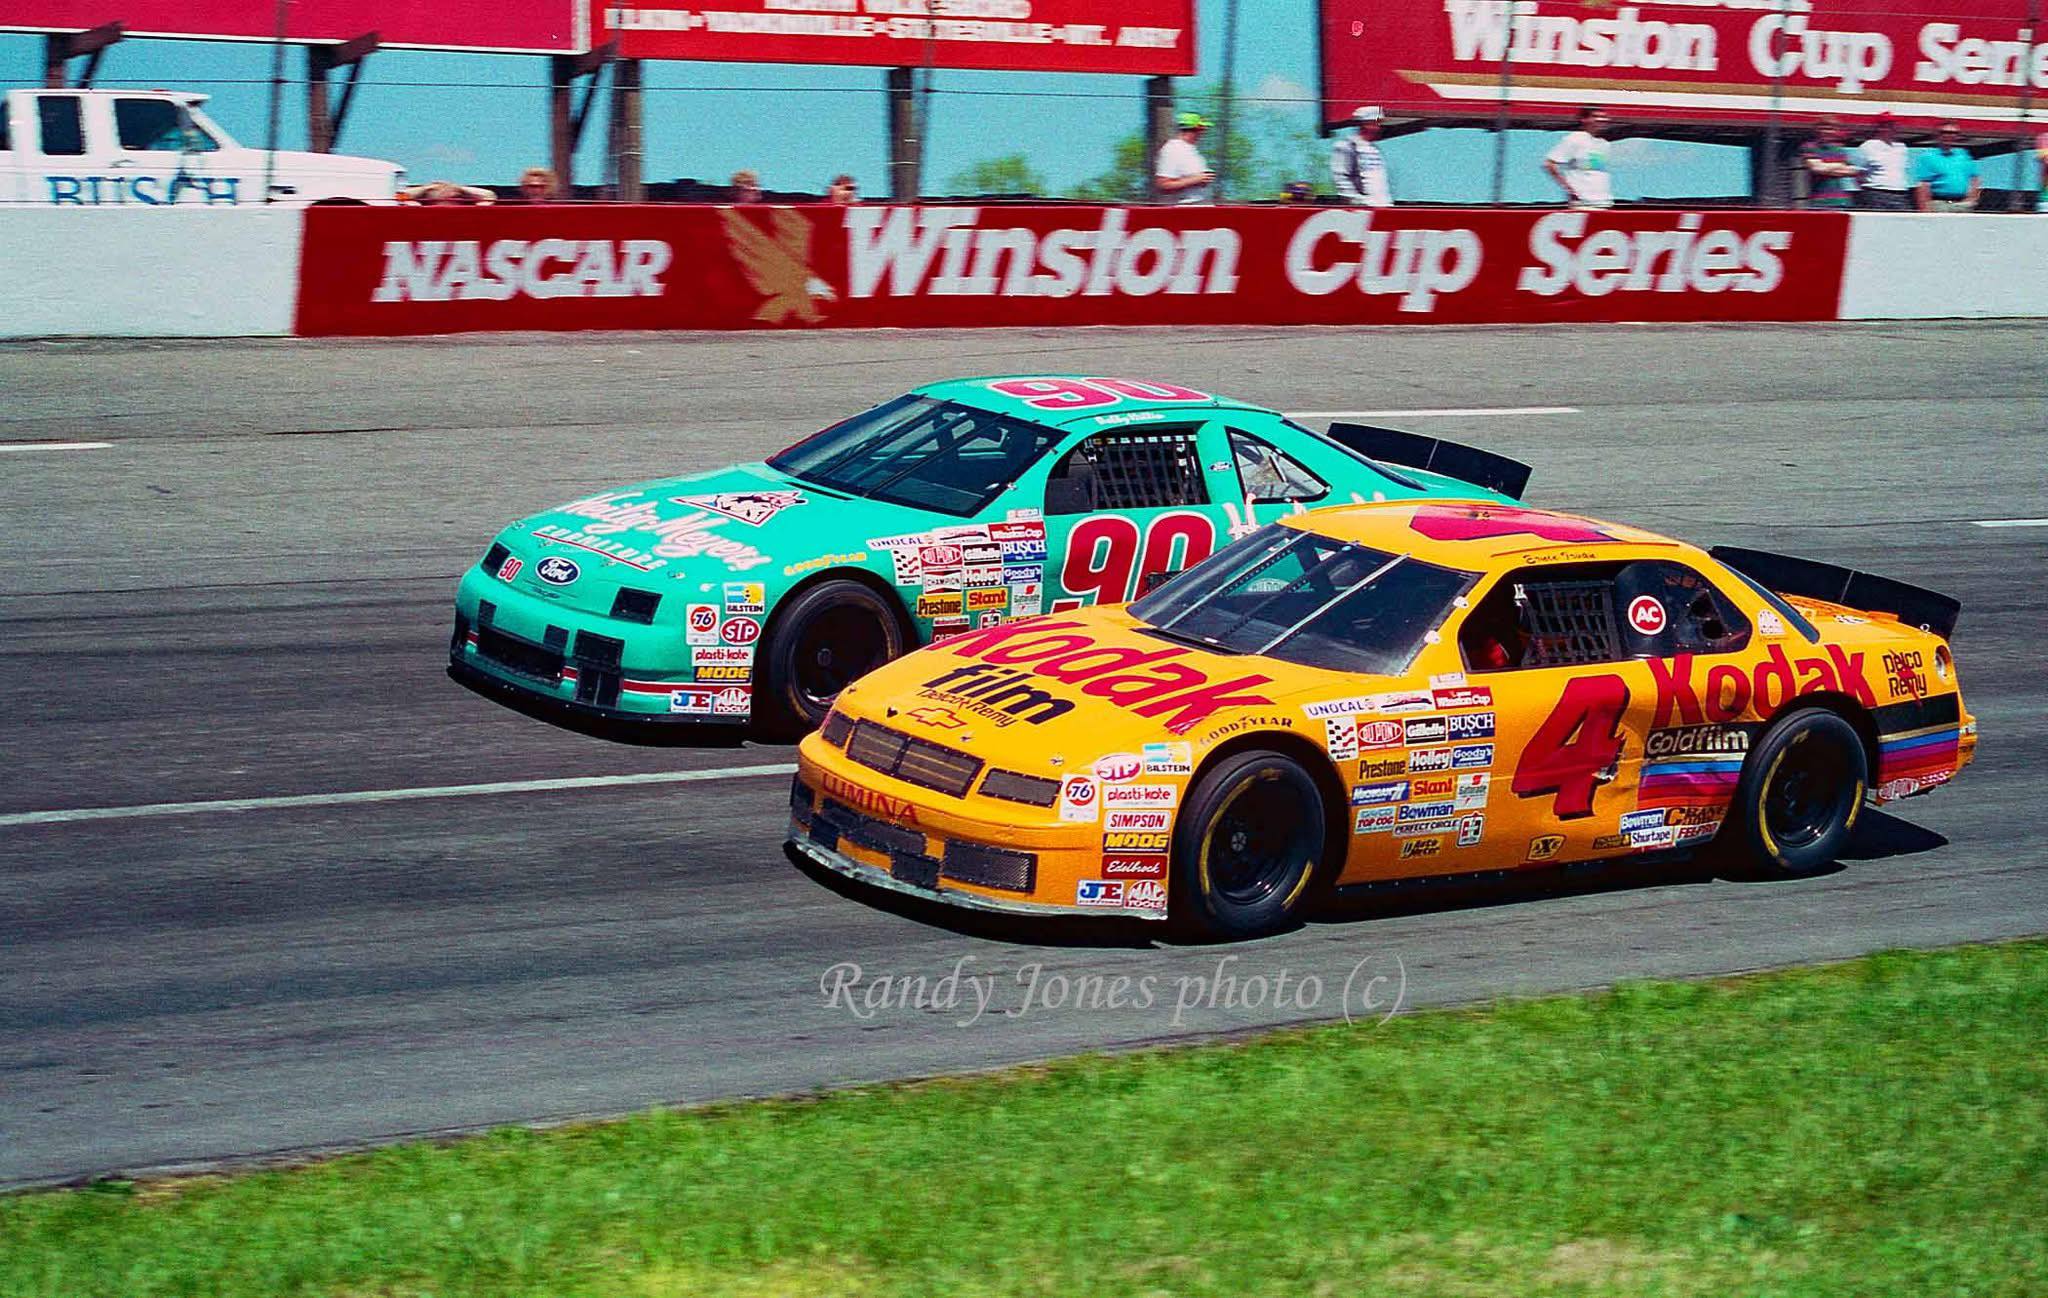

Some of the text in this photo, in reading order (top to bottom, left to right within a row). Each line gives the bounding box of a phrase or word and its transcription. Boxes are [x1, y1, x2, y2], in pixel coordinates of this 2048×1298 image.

[1444, 0, 1718, 70] Winston
[1748, 14, 1894, 94] Cup
[842, 207, 1794, 313] Winston Cup Series
[371, 238, 673, 303] NASCAR
[986, 377, 1213, 411] 90
[870, 537, 925, 548] UNOCAL
[1002, 541, 1046, 554] BUSCH
[1060, 510, 1217, 606] 90
[499, 557, 525, 583] 90
[541, 559, 573, 582] Ford
[925, 576, 961, 587] CHAMPION
[917, 597, 962, 617] Prestone
[968, 591, 1007, 606] Stant
[726, 605, 764, 613] BILSTEIN
[1636, 606, 1661, 625] AC
[694, 614, 713, 626] 76
[724, 620, 756, 641] STP
[695, 648, 749, 661] plasti-kote
[1881, 650, 1924, 675] Delco
[695, 666, 750, 679] MOOG
[926, 616, 1277, 737] Kodak
[921, 663, 1077, 726] film
[1646, 643, 1877, 729] Kodak
[1888, 673, 1929, 698] Remy
[673, 692, 710, 708] JE
[916, 688, 1020, 729] Delco Remy
[1308, 700, 1365, 717] UNOCAL
[1406, 722, 1446, 738] Gillette
[1450, 713, 1495, 731] BUSCH
[1453, 746, 1493, 760] Goody's
[1511, 672, 1632, 824] 4
[1409, 749, 1450, 769] Holley
[1097, 762, 1139, 781] STP
[1146, 764, 1191, 773] BILSTEIN
[1359, 760, 1407, 780] Prestone
[1071, 784, 1091, 799] 76
[1107, 787, 1172, 801] plasti-kote
[1413, 778, 1453, 796] Stant
[820, 773, 922, 826] LUMINA
[1110, 814, 1166, 828] SIMPSON
[1398, 804, 1455, 820] Bowman
[1621, 812, 1664, 830] Bowman
[1394, 819, 1459, 835] PERFECT CIRCLE
[1104, 834, 1170, 848] MOOG
[1632, 828, 1671, 846] Shurtape
[1106, 861, 1161, 874] Edelbrock
[1079, 882, 1123, 900] JE
